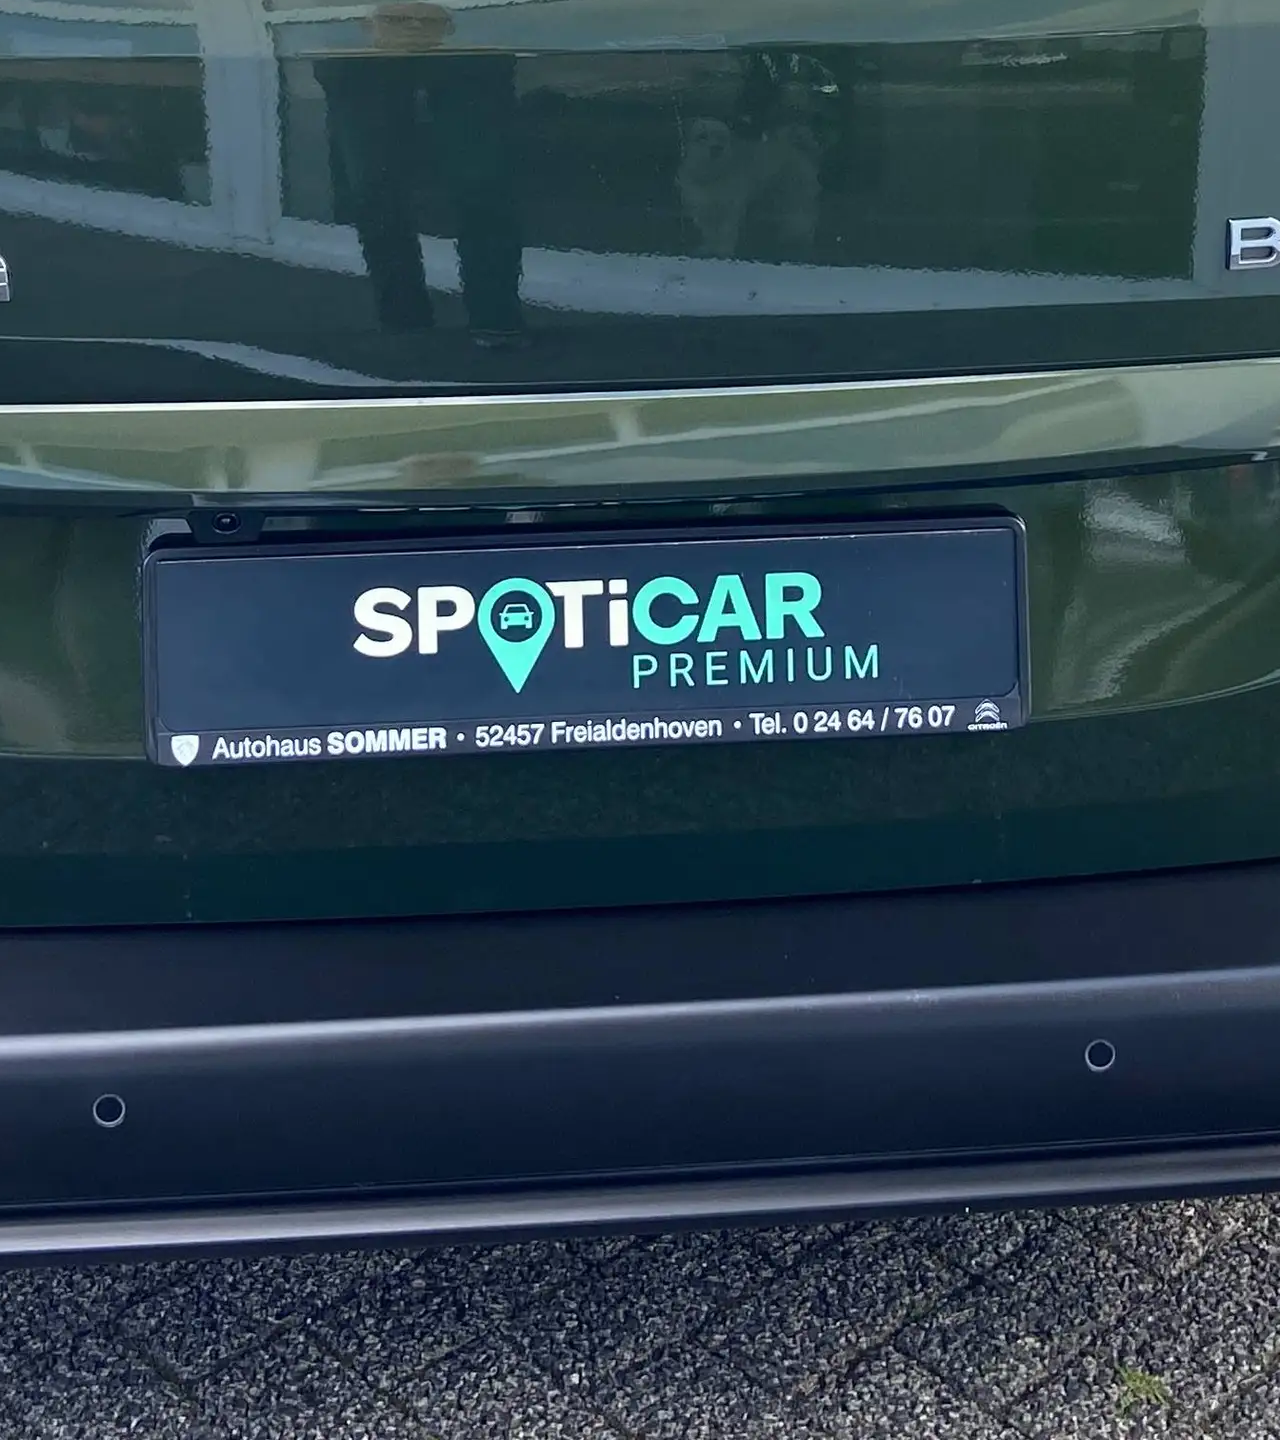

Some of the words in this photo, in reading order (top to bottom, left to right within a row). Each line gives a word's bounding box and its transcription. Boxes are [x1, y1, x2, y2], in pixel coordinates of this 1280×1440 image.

[632, 644, 879, 689] PREMIUM
[212, 734, 321, 759] Autohaus
[327, 727, 447, 754] SOMMER
[475, 724, 544, 747] 52457
[551, 716, 723, 744] Freialdenhoven
[749, 711, 787, 735] Tel.
[793, 711, 809, 734] 0
[813, 710, 841, 732] 24
[847, 709, 875, 732] 64
[894, 706, 923, 728] 76
[927, 705, 956, 728] 07
